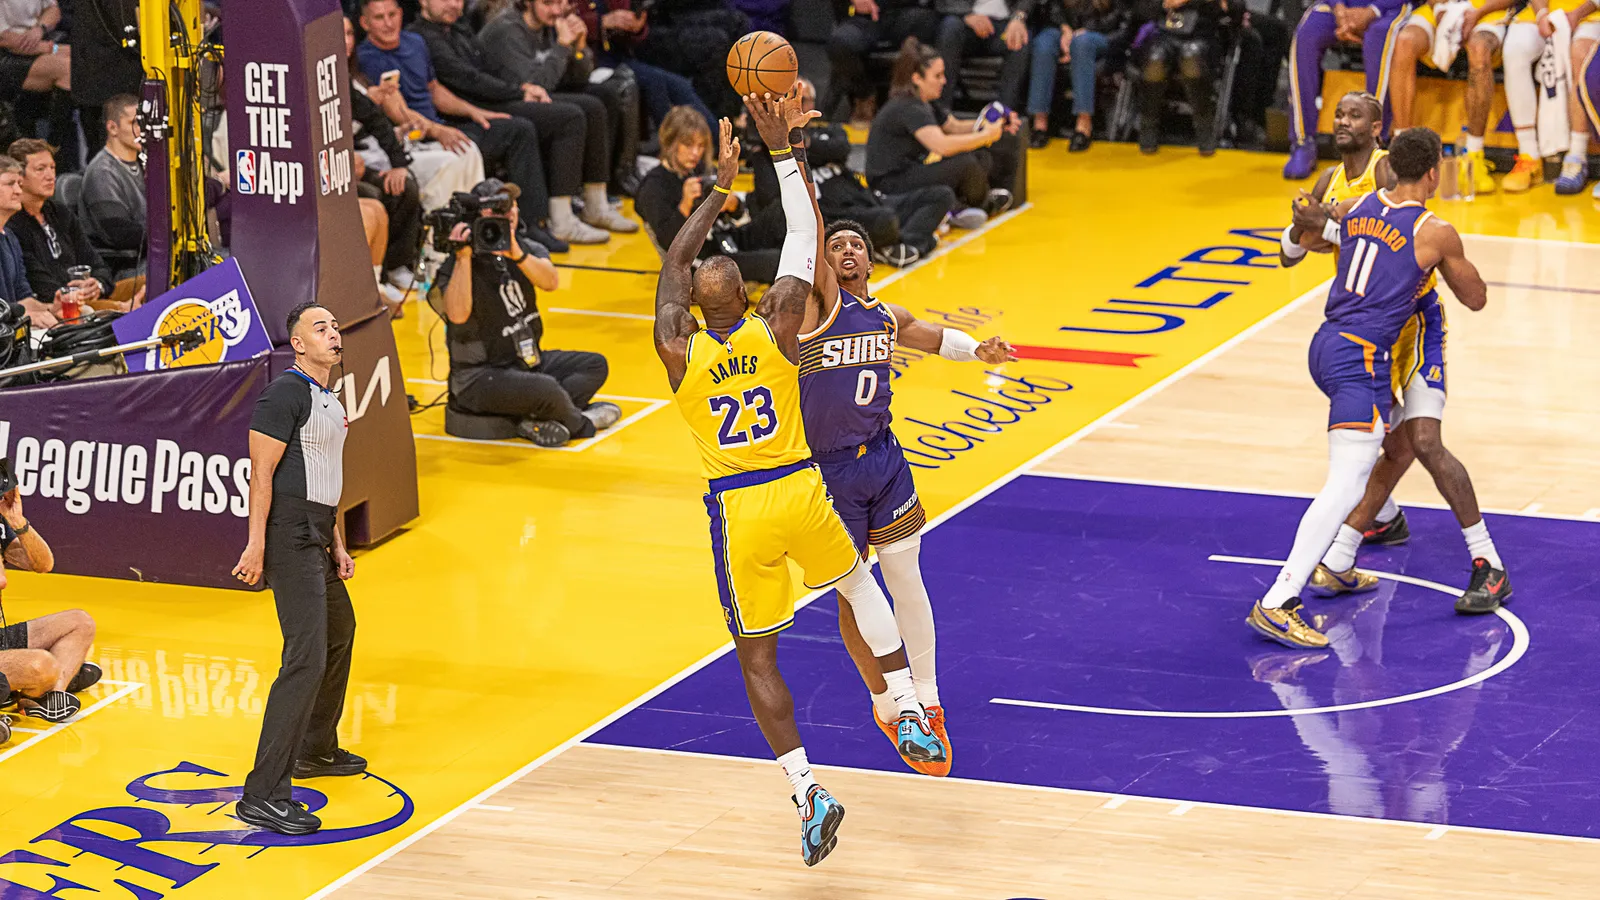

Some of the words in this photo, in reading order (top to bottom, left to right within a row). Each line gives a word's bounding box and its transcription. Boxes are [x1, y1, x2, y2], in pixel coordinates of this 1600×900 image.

[244, 62, 289, 104] GET
[316, 54, 337, 102] GET
[245, 106, 292, 149] THE
[319, 98, 343, 145] THE
[258, 151, 304, 204] App
[329, 147, 351, 196] App
[1346, 216, 1407, 252] IGHODARO
[1345, 237, 1379, 297] 11
[708, 355, 759, 385] JAMES
[821, 334, 889, 368] SUNS
[854, 369, 878, 406] 0
[707, 384, 780, 450] 23
[150, 438, 251, 518] Pass
